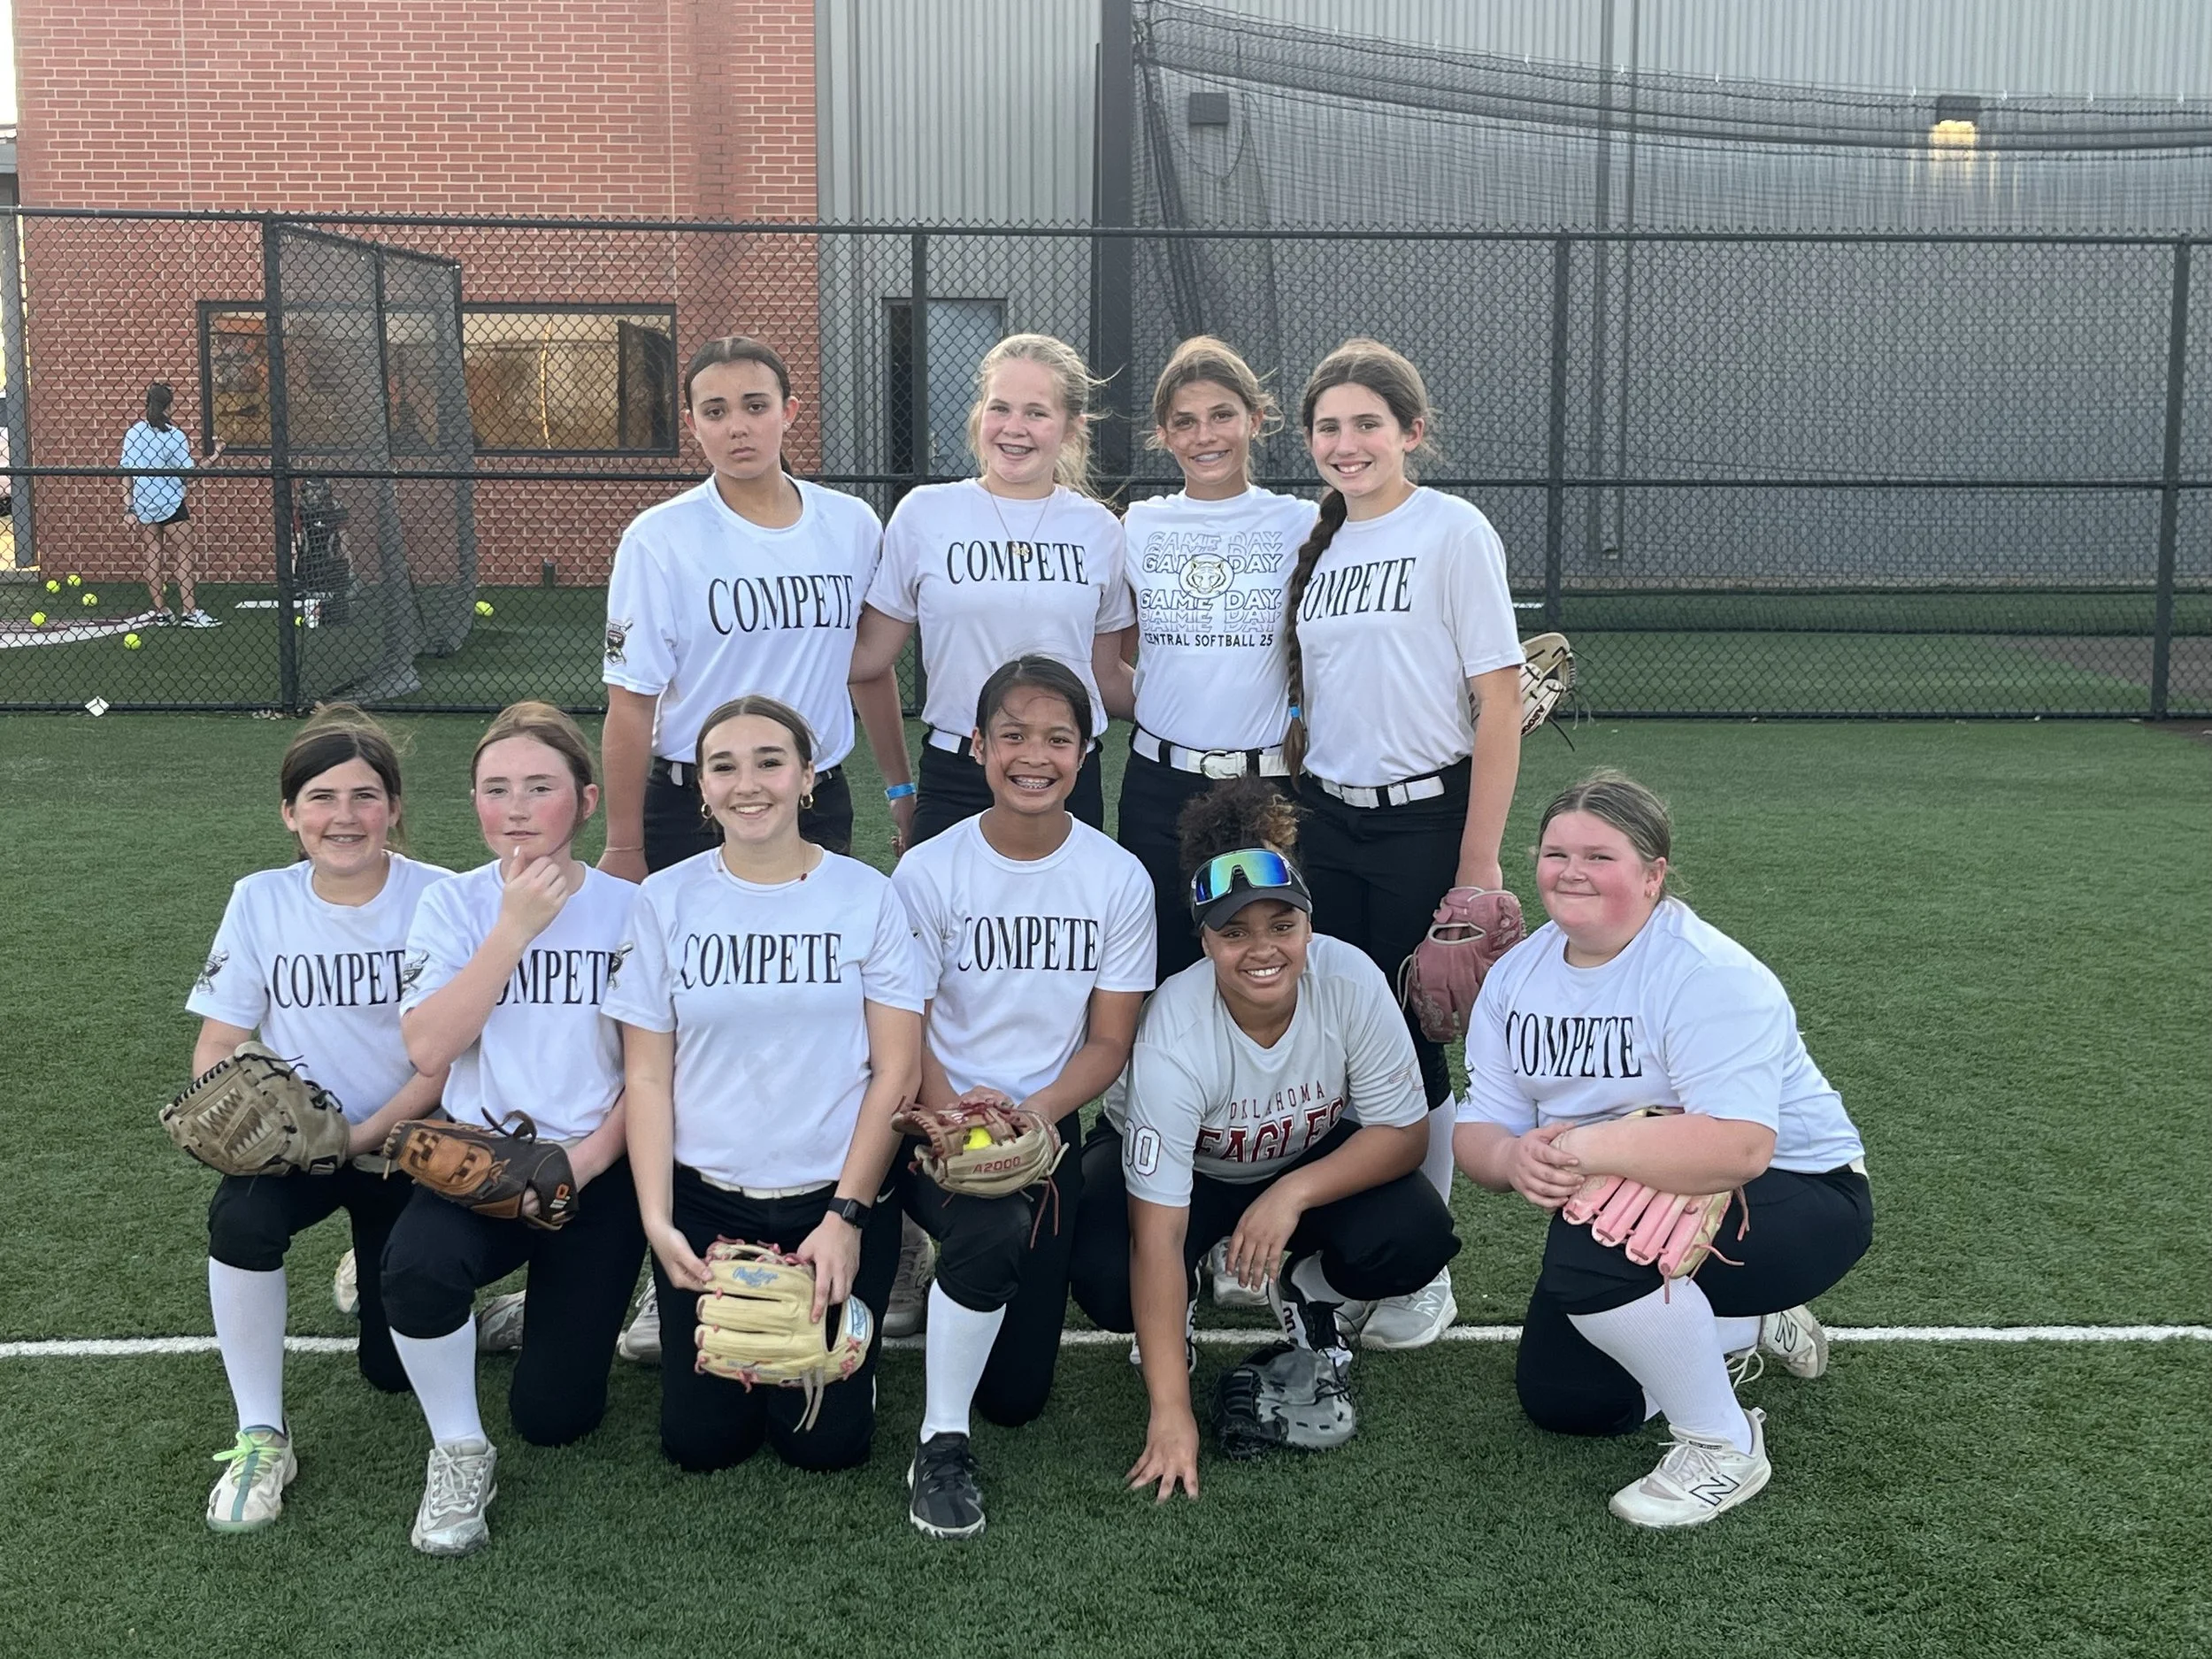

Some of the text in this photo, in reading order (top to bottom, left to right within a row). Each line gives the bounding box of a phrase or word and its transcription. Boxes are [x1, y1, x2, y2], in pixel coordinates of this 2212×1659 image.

[947, 541, 1089, 585] COMPETE
[1227, 553, 1283, 573] DAY
[1140, 588, 1281, 611] GAME DAY
[1302, 557, 1416, 621] OMPETE
[1145, 633, 1273, 647] CENTRAL SOFTBALL 25
[273, 949, 406, 1009] COMPET
[680, 933, 842, 989] COMPETE
[1506, 1010, 1642, 1078] COMPETE
[973, 1156, 1021, 1173] A2000
